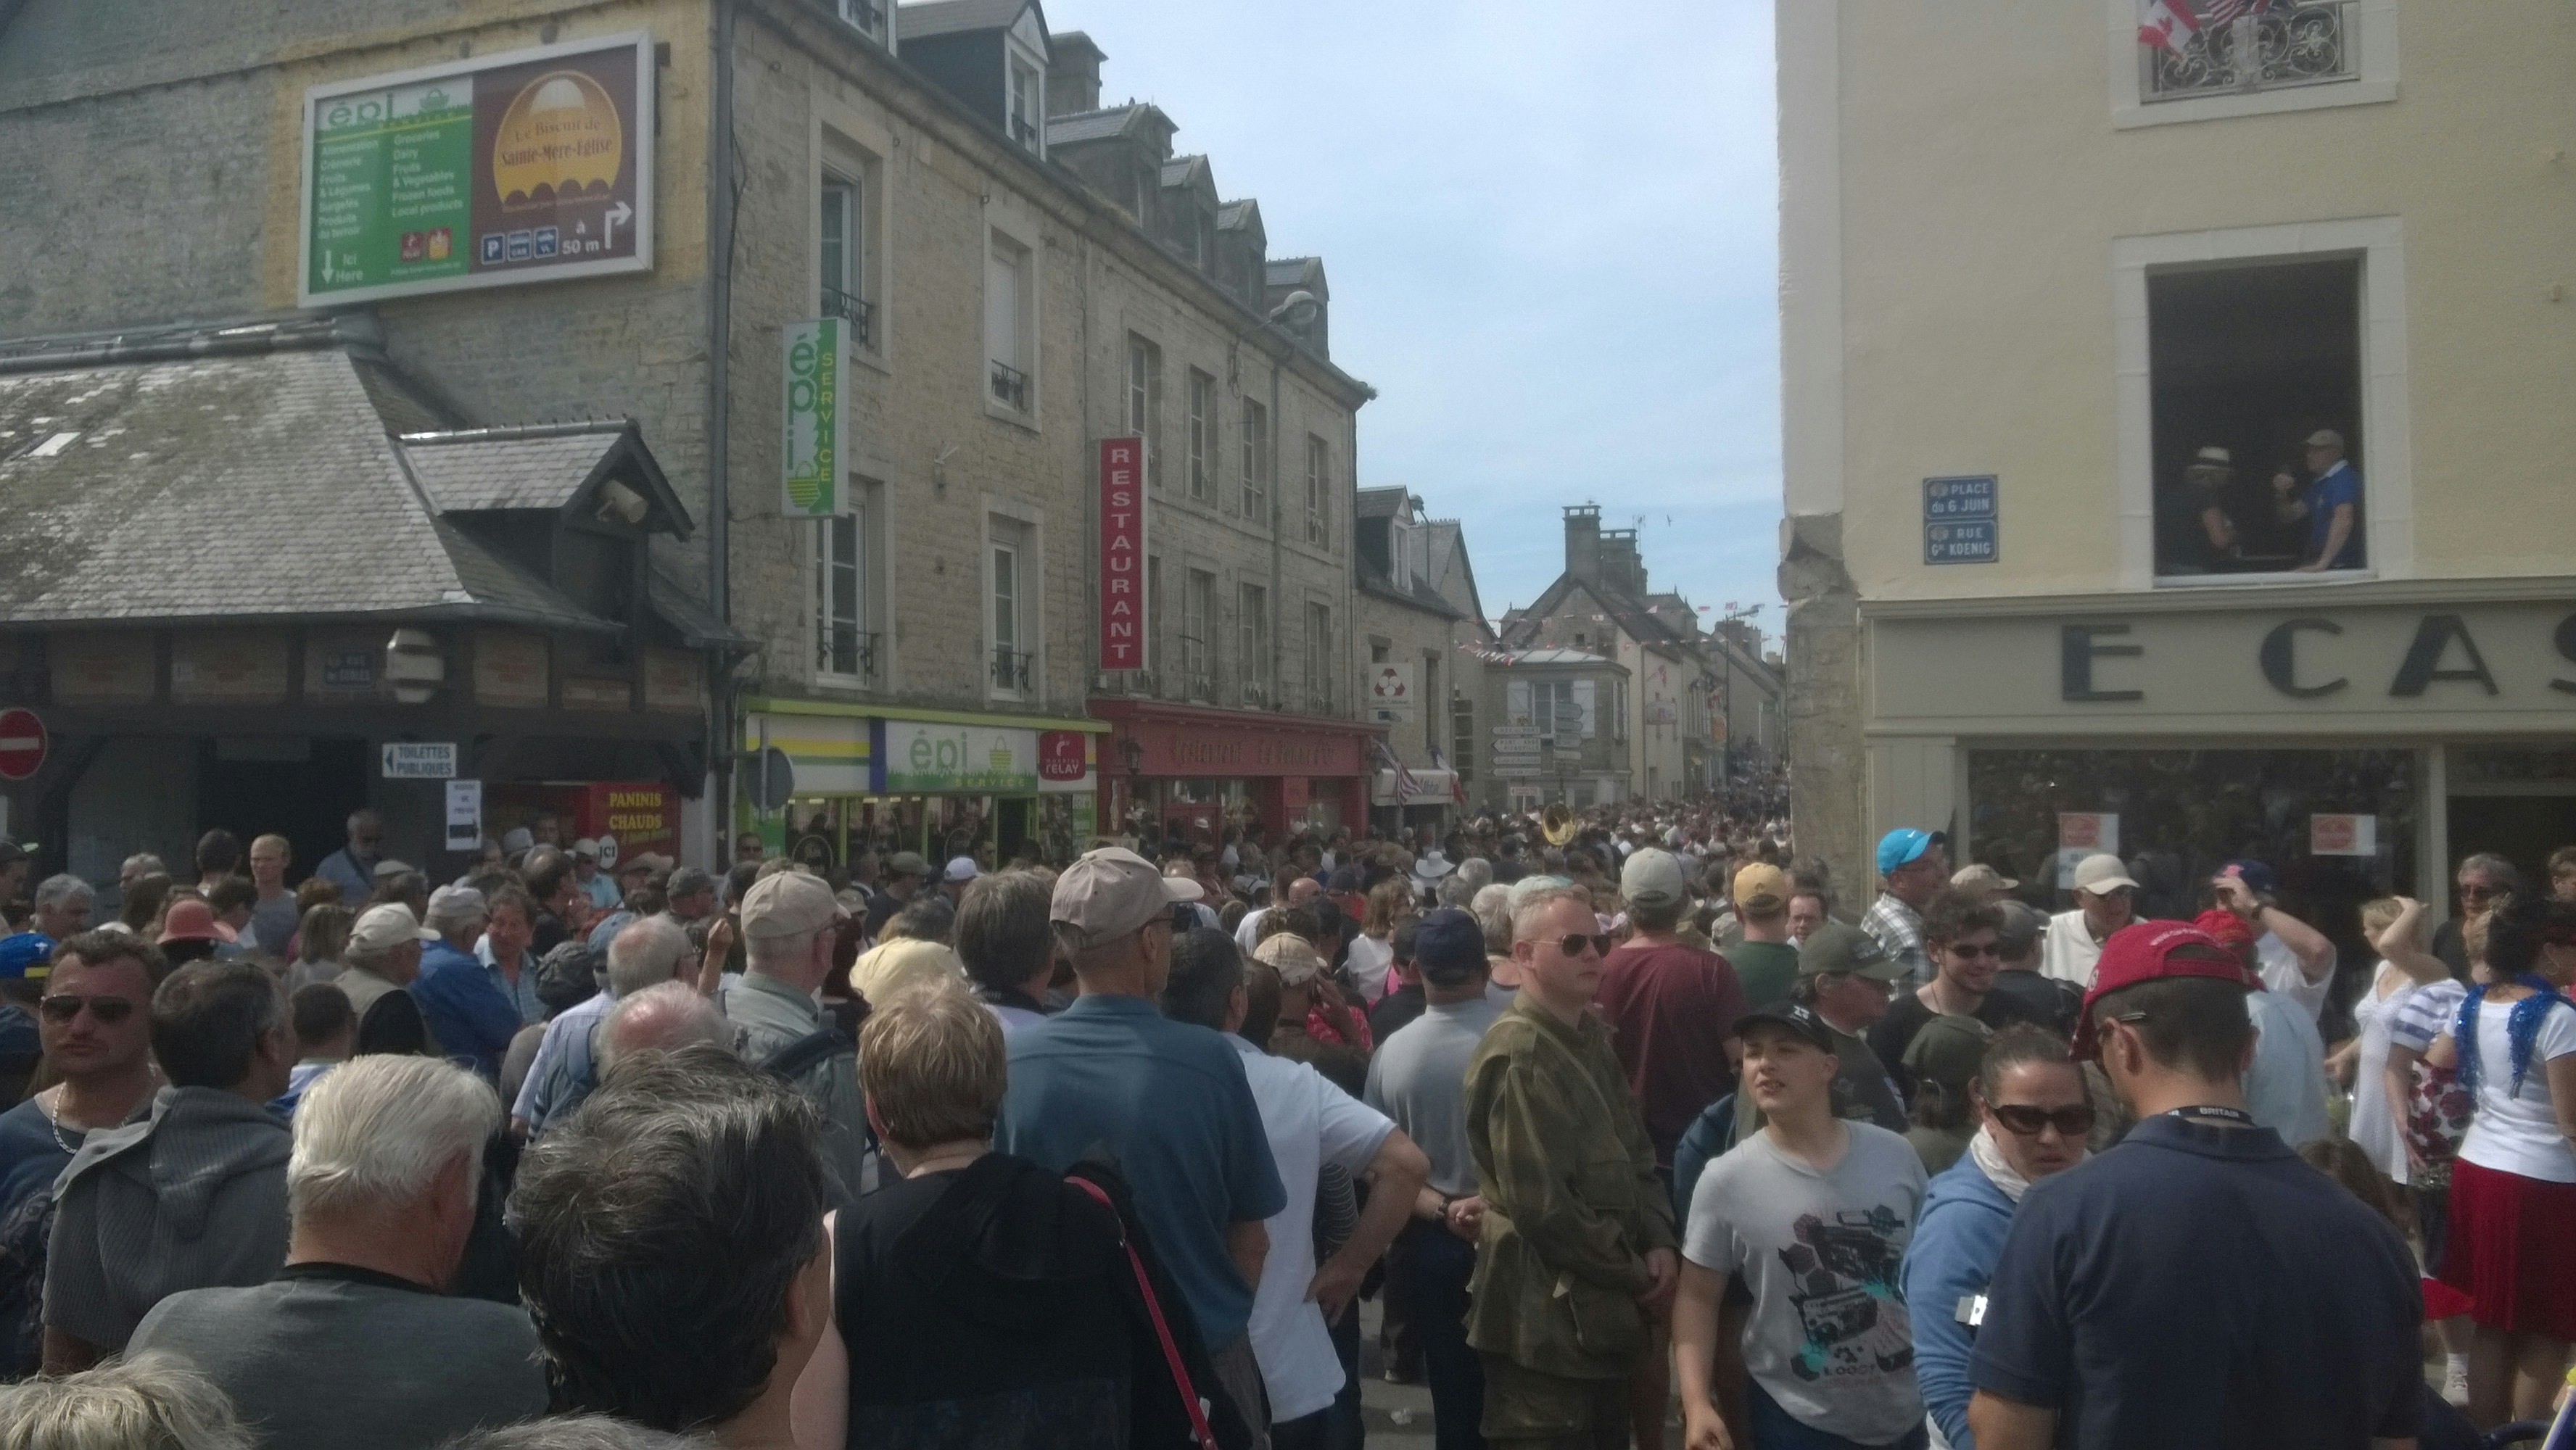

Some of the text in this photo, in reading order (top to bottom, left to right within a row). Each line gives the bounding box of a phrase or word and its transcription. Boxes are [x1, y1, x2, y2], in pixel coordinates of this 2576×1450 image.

[328, 92, 393, 127] épi
[514, 118, 601, 142] Le Biscuit de
[393, 149, 418, 160] Dairy
[392, 162, 421, 175] Fruits
[392, 189, 425, 202] Frozen
[392, 199, 463, 218] Local products
[576, 220, 586, 234] à
[487, 240, 499, 258] P
[562, 239, 600, 254] 50 m
[343, 252, 358, 266] Ici
[335, 269, 363, 283] Here
[788, 333, 816, 471] épi
[820, 353, 833, 481] SERVICE
[1951, 484, 1989, 494] PLACE
[1932, 498, 1990, 513] du 6 JUIN
[1957, 528, 1983, 539] RUE
[1110, 448, 1131, 659] RESTAURANT
[1949, 542, 1991, 556] KOENIG
[2061, 624, 2144, 701] E
[398, 747, 451, 760] TOILETTES
[909, 729, 967, 774] épi
[397, 762, 452, 776] PUBLIQUES
[954, 777, 1025, 787] SERVICE
[610, 792, 661, 807] PANINIS
[610, 814, 662, 830] CHAUDS
